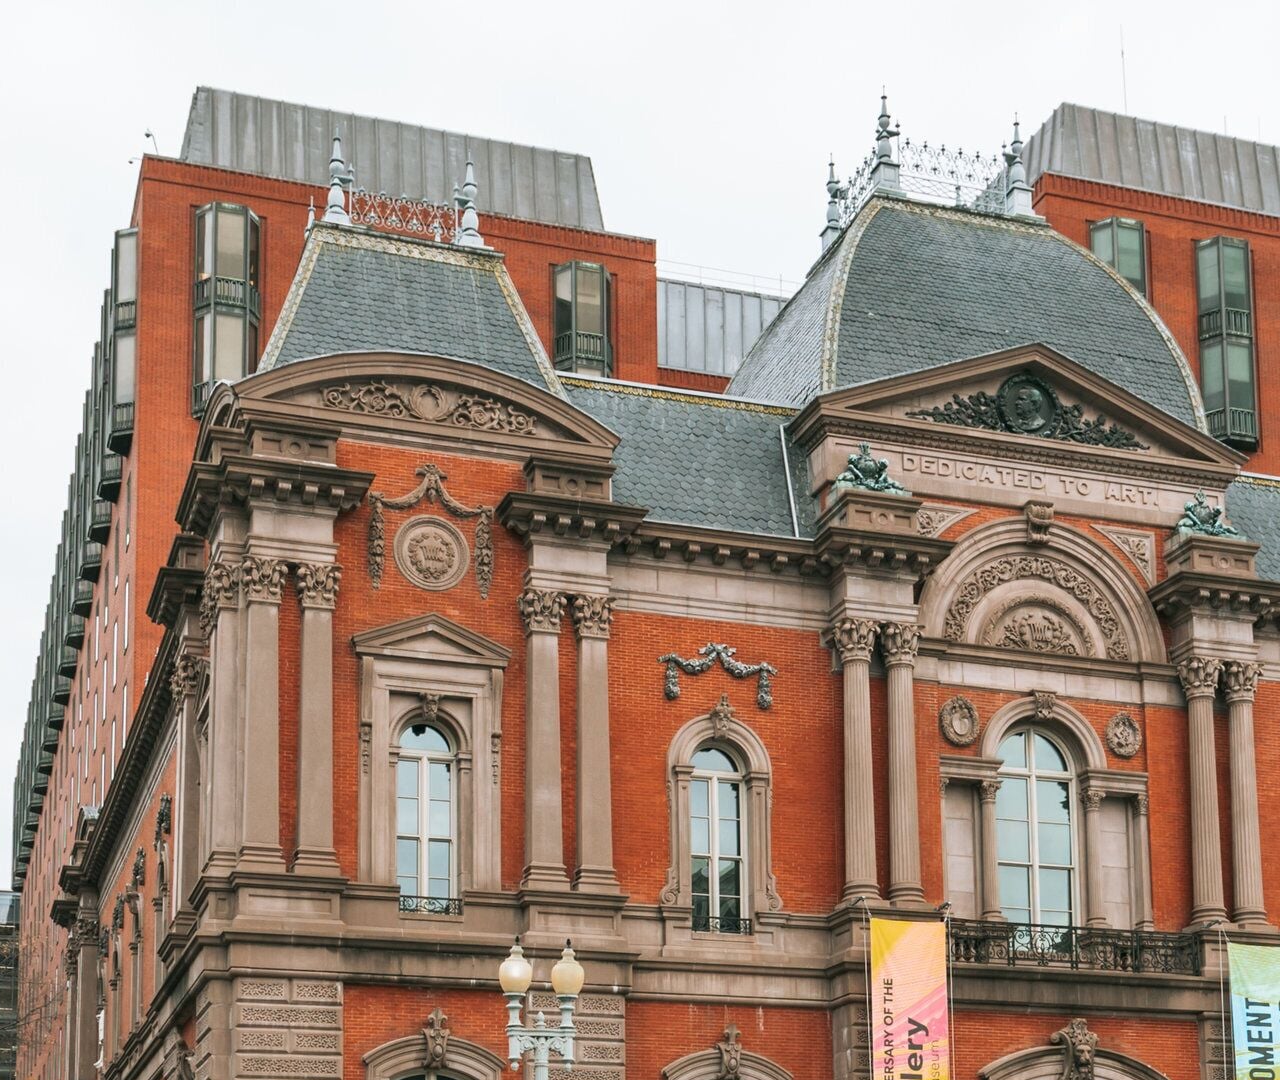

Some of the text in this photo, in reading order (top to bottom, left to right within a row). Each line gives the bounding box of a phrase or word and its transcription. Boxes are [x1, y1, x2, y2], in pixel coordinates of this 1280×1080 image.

[902, 452, 1159, 507] DEDICATED TO ART.
[883, 978, 893, 1005] THE
[883, 1008, 894, 1026] OF
